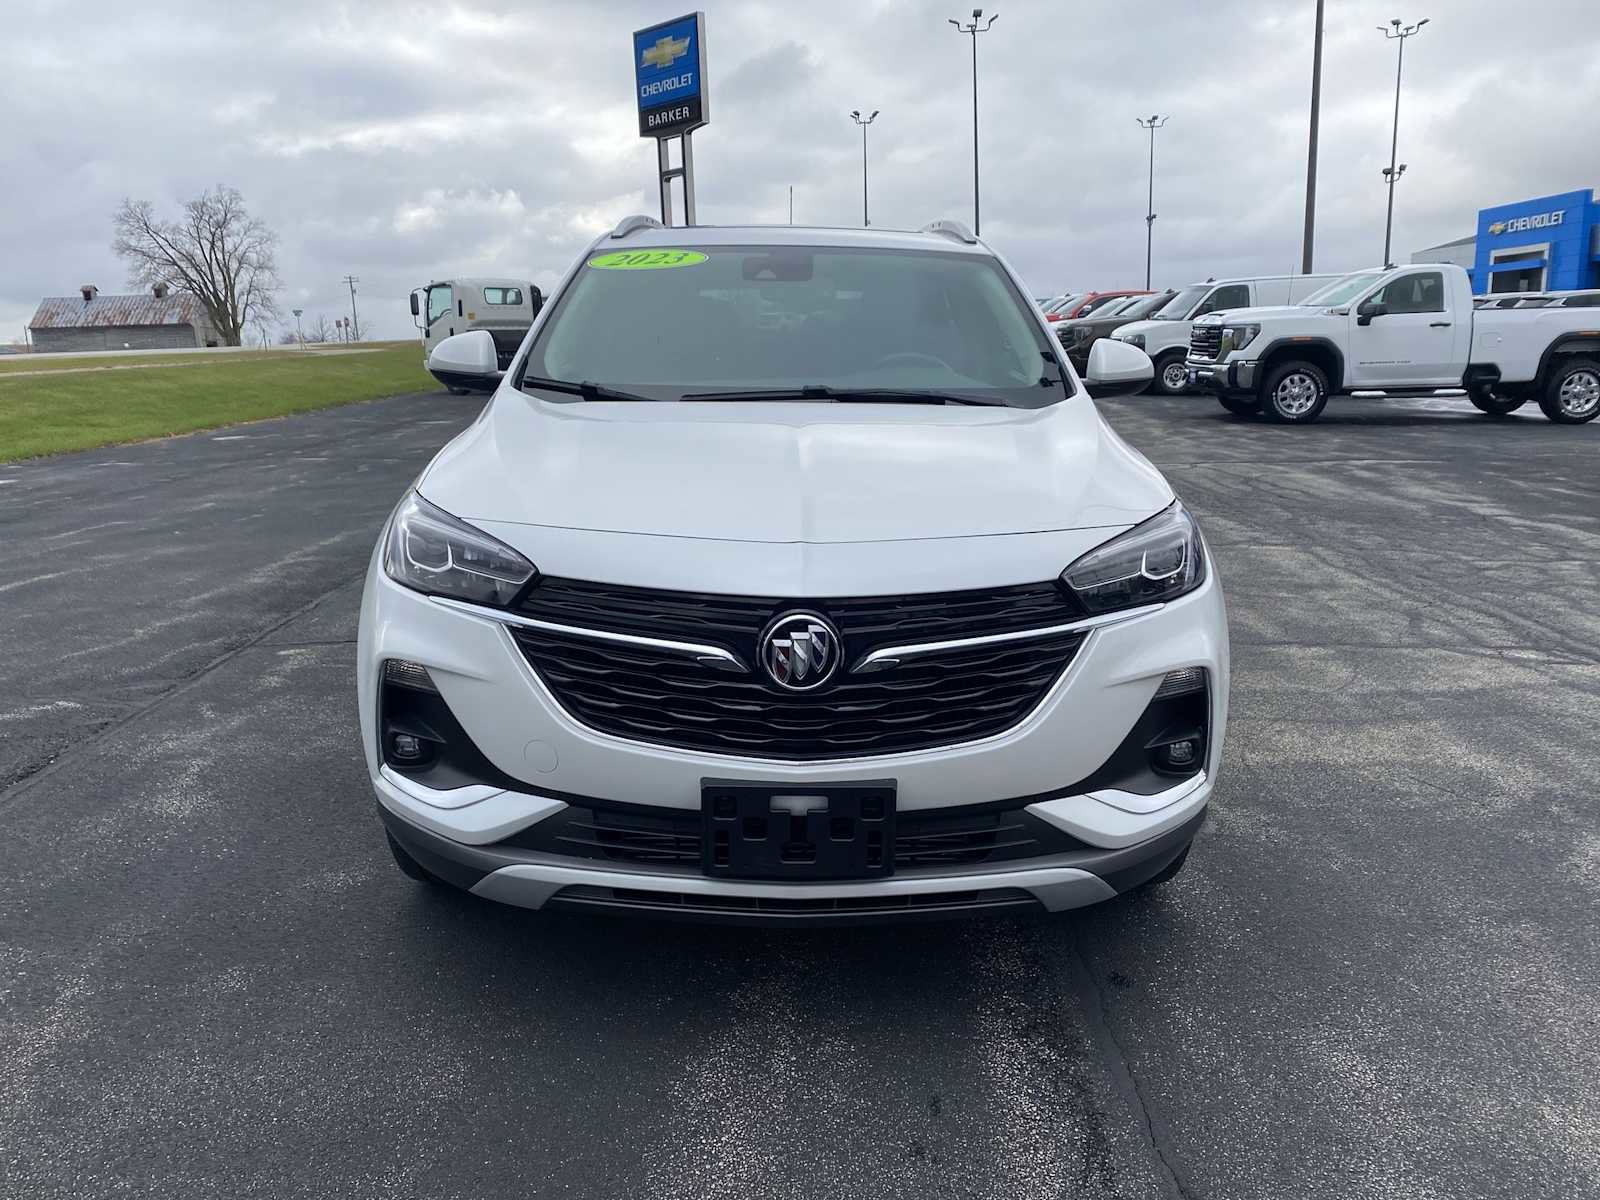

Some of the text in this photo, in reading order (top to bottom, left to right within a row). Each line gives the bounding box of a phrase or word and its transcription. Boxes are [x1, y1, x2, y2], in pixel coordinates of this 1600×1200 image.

[641, 73, 693, 97] CHEVROLET
[648, 106, 690, 127] BARKER
[1507, 210, 1567, 233] CHEVROLET
[606, 252, 689, 266] 2023
